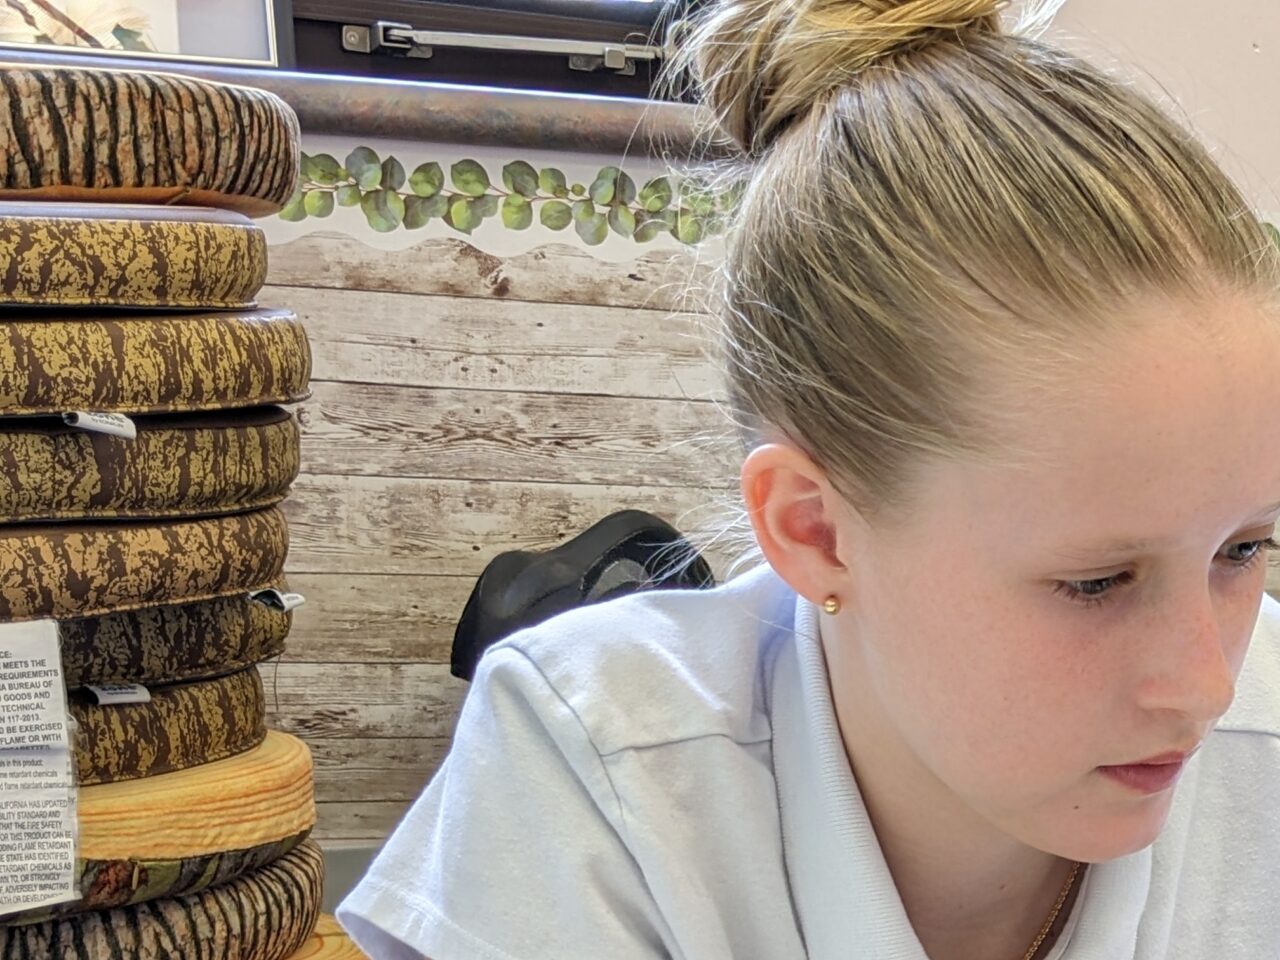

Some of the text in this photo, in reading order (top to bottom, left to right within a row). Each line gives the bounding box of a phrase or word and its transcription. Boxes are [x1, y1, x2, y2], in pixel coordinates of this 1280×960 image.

[3, 659, 46, 670] MEETS THE
[8, 681, 41, 691] BUREAU
[42, 680, 53, 688] OF
[4, 691, 50, 702] GOODS AND
[1, 702, 46, 713] TECHNICAL
[19, 722, 63, 733] EXERCISED
[41, 733, 62, 742] WITH
